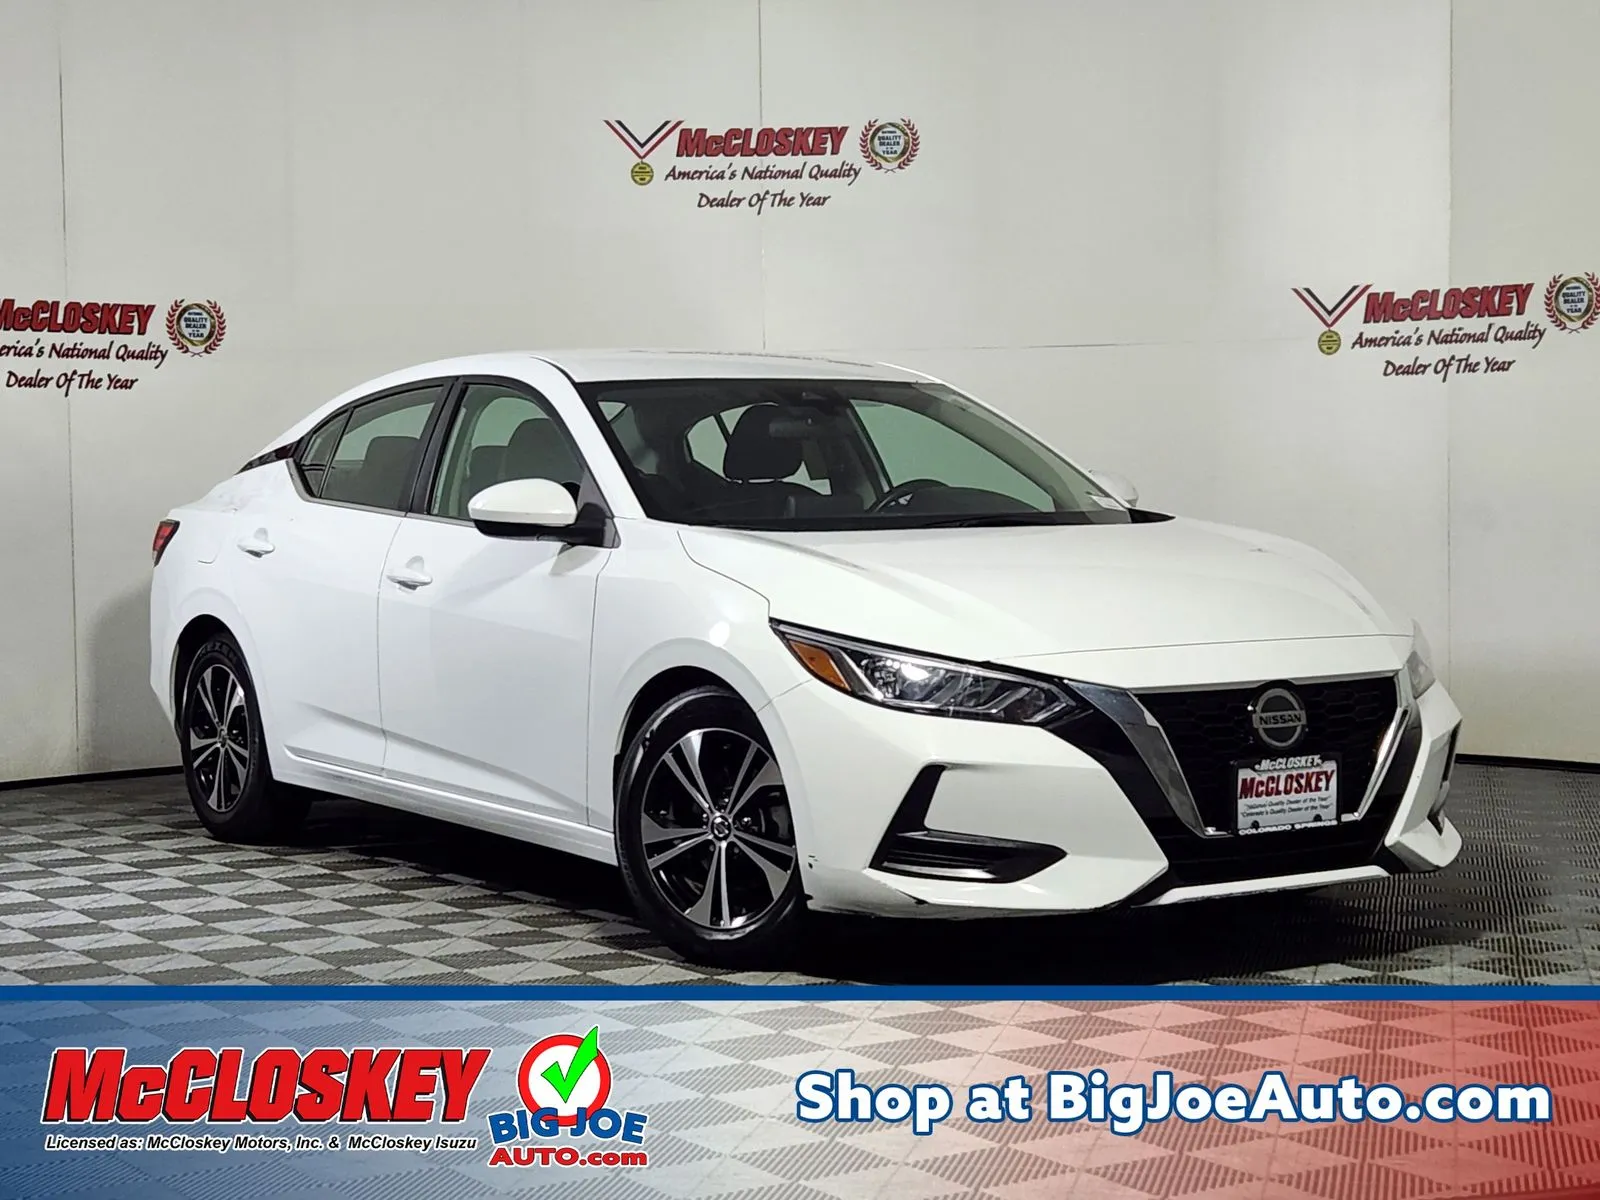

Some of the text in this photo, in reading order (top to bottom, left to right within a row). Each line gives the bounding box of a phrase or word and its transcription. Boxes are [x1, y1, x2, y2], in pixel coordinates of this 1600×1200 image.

[676, 126, 849, 157] McCLOSKEY
[664, 162, 736, 181] America's
[741, 161, 807, 181] National
[808, 160, 862, 186] Quality
[697, 189, 831, 215] Dealer Of The Year
[1362, 282, 1535, 324] McCLOSKEY
[1351, 327, 1423, 349] America's
[1427, 322, 1495, 346] National
[1494, 320, 1547, 349] Quality
[48, 340, 114, 360] National
[115, 341, 169, 369] Quality
[1382, 353, 1516, 383] Dealer Of The Year
[5, 367, 139, 398] Dealer Of The Year
[1259, 713, 1301, 725] NISSAN
[1259, 754, 1320, 770] McCLOSKEY
[1239, 769, 1335, 800] McCLOSKEY
